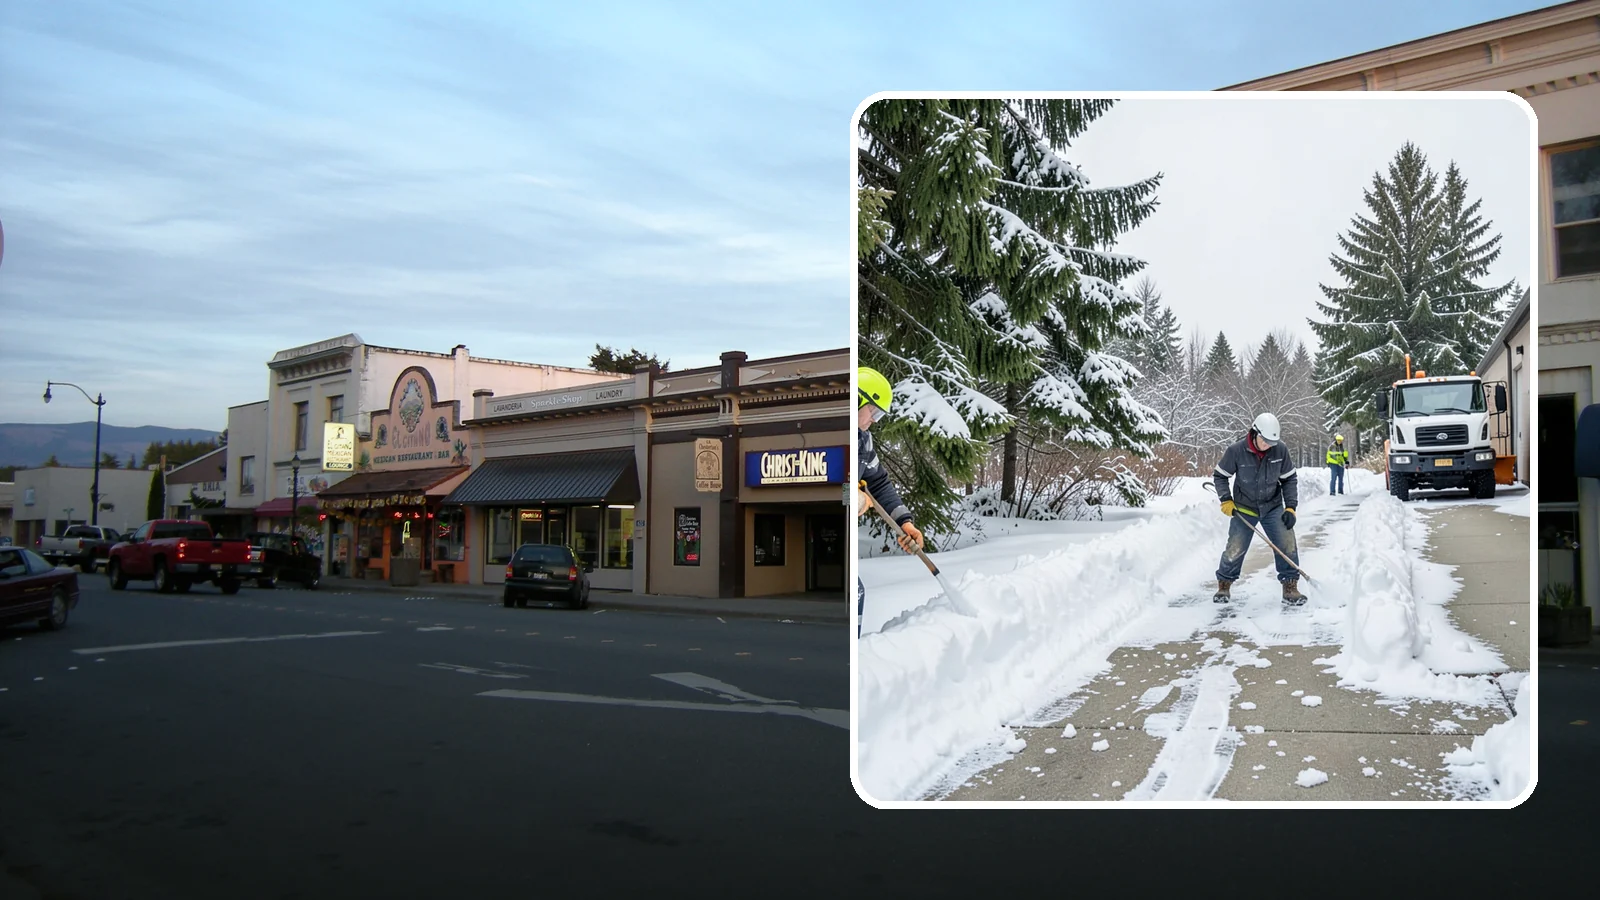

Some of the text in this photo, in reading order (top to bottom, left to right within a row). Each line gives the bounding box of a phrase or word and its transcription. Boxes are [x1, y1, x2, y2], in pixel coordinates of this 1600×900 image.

[531, 394, 583, 409] Sparkle Shop
[595, 389, 624, 400] LAUNDRY
[493, 402, 523, 413] LAVANDERIA
[373, 455, 396, 464] MEXICAN
[397, 451, 434, 462] RESTAURANT
[438, 450, 450, 460] BAR
[761, 450, 828, 478] CHRIST KING
